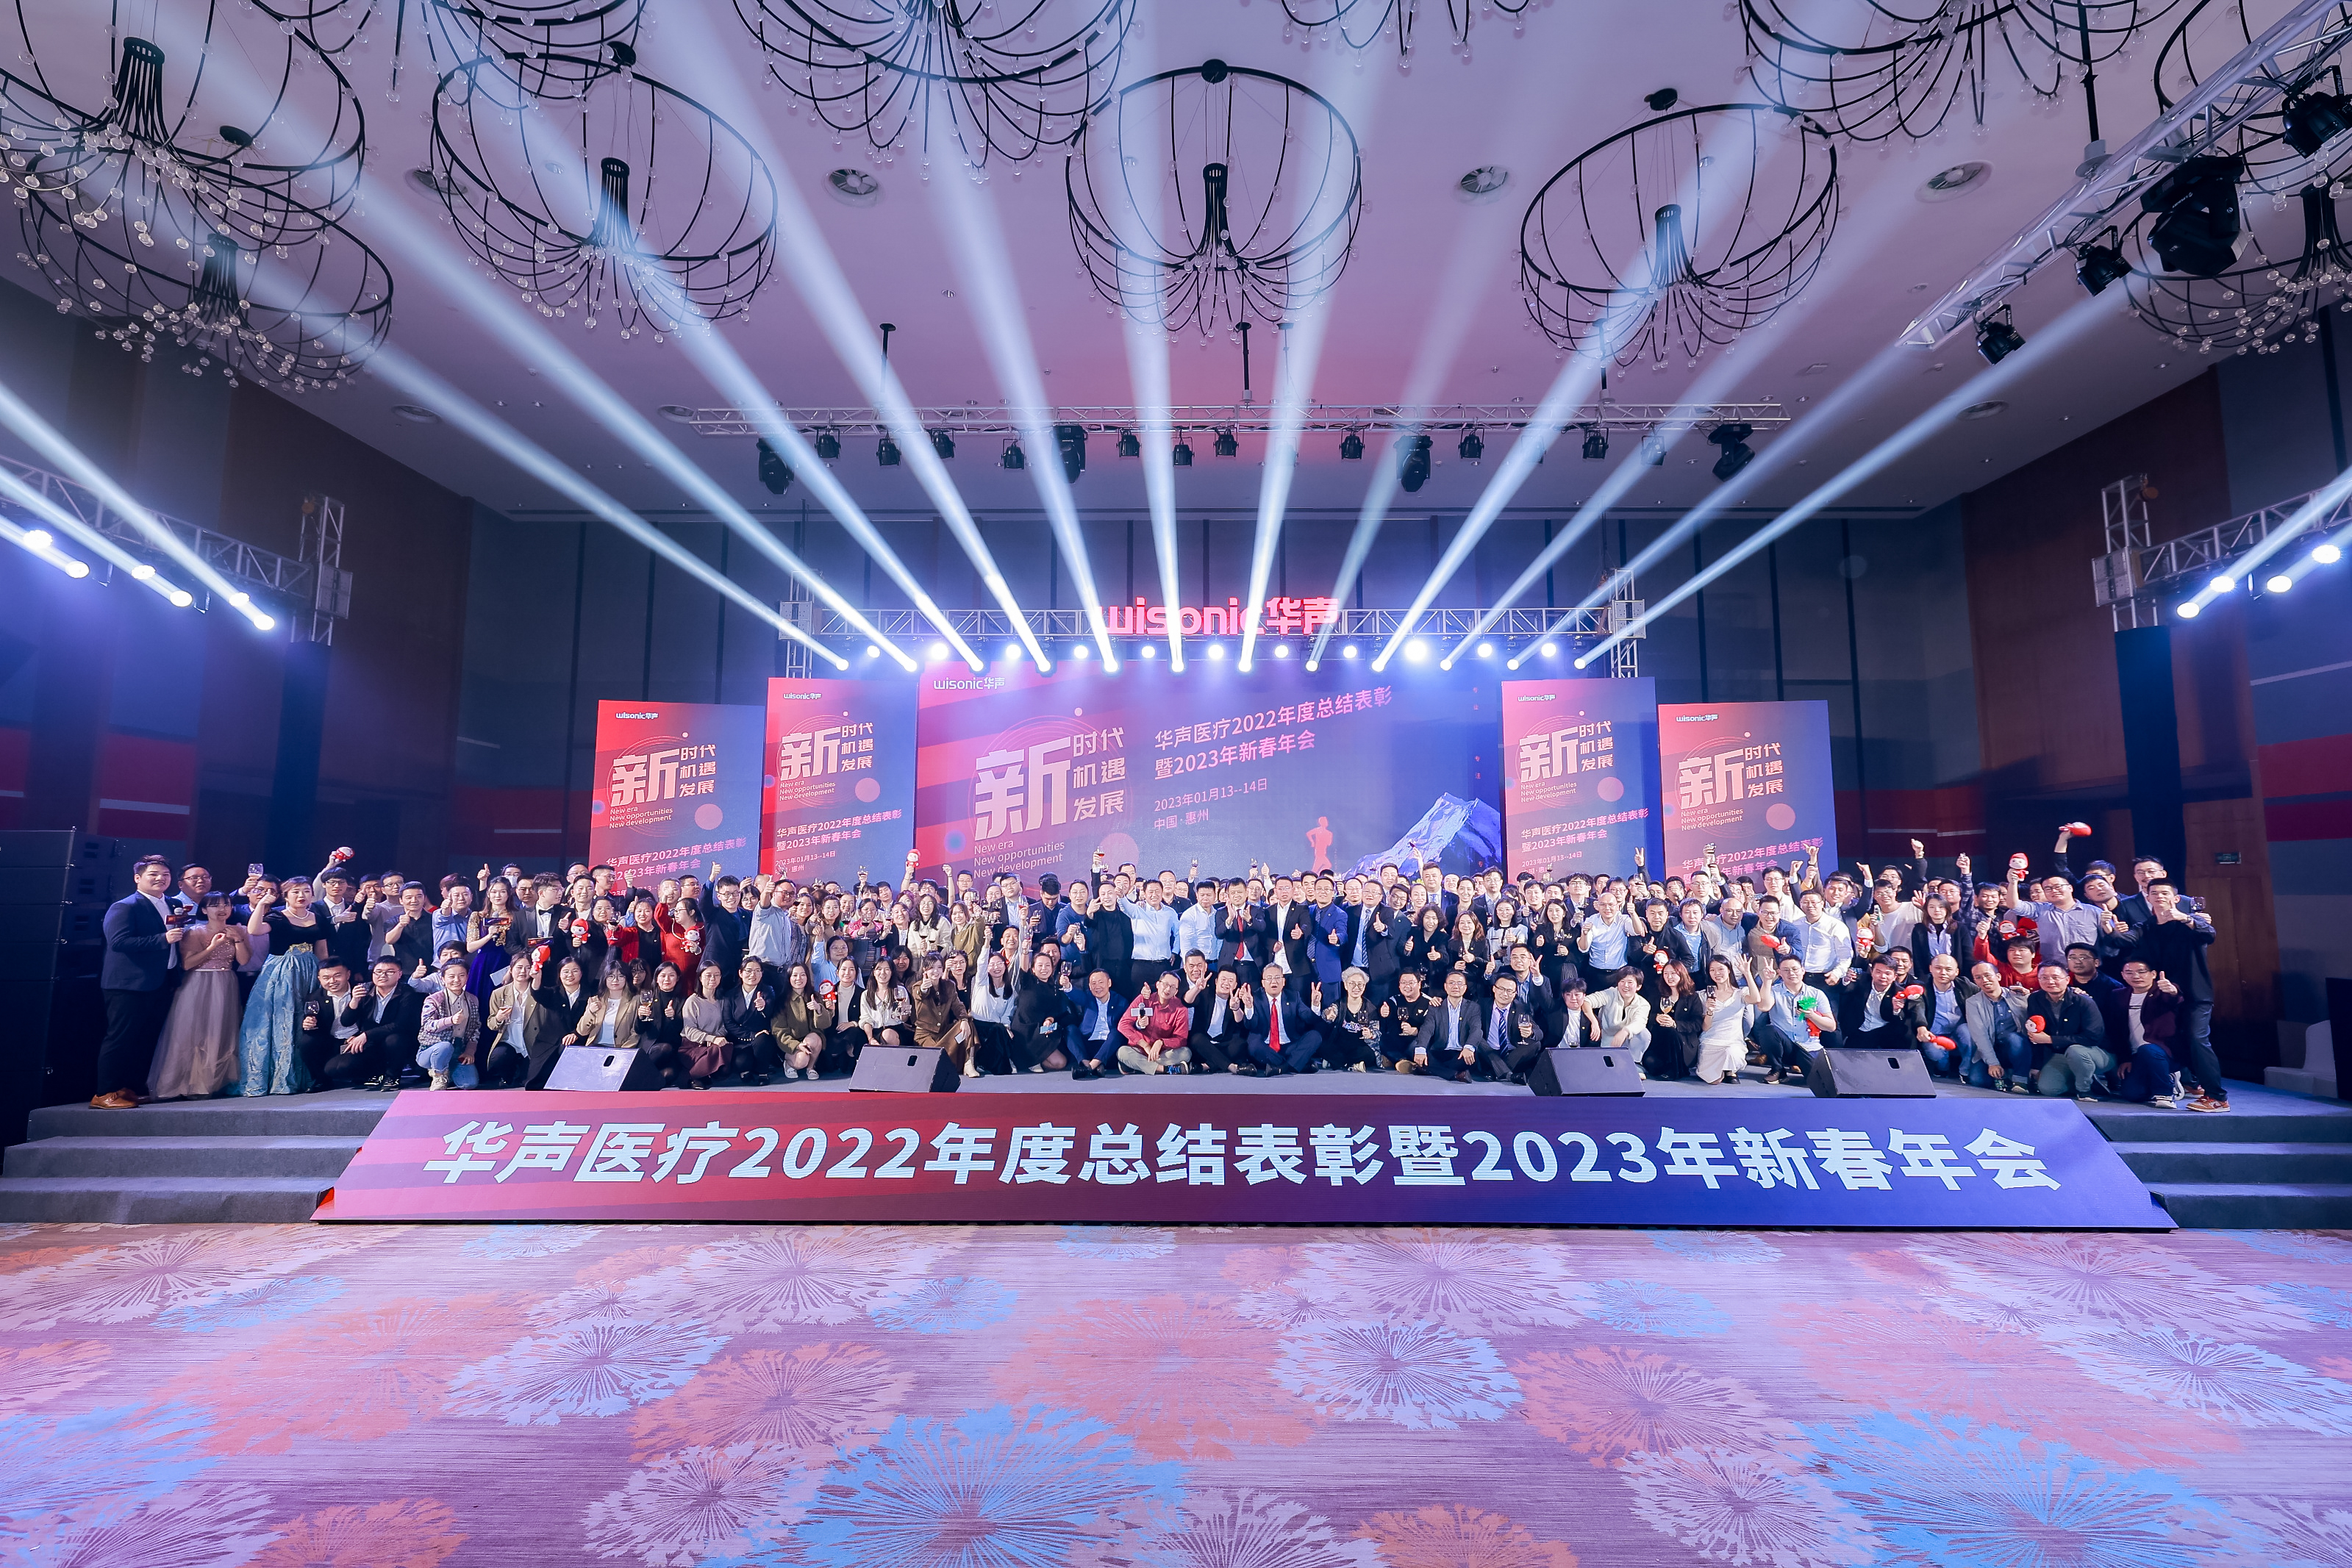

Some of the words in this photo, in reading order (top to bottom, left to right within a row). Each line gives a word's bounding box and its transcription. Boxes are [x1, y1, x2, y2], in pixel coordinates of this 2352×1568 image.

[933, 677, 1005, 690] wisonic华声
[1154, 685, 1393, 751] 华声医疗2022年度总结表彰
[841, 722, 873, 738] 时代
[1579, 720, 1612, 738] 时代
[840, 738, 873, 755] 机遇
[1073, 726, 1125, 757] 时代
[1579, 737, 1614, 755] 机遇
[680, 744, 716, 761] 时代
[780, 726, 841, 781] 新
[1154, 729, 1316, 780] 暨2023年新春年会
[1520, 726, 1579, 783] 新
[1745, 742, 1781, 761] 时代
[679, 761, 716, 779] 机遇
[840, 755, 873, 773] 发展
[1581, 753, 1614, 772] 发展
[1745, 760, 1784, 779] 机遇
[610, 748, 680, 807] 新
[1073, 757, 1126, 790] 机遇
[1679, 748, 1745, 809] 新
[679, 780, 715, 798] 发展
[794, 781, 836, 793] opportunities
[794, 787, 835, 799] development
[974, 736, 1071, 841] 新
[1154, 778, 1268, 812] 2023年01月13--14日
[1535, 781, 1577, 795] opportunities
[1535, 789, 1576, 800] development
[1747, 778, 1784, 798] 发展
[610, 814, 625, 822] New
[626, 807, 673, 820] opportunities
[1073, 789, 1125, 822] 发展
[626, 815, 672, 826] development
[776, 809, 902, 838] 华声医疗2022年度总结表彰
[1521, 808, 1648, 840] 华声医疗2022年度总结表彰
[1697, 809, 1744, 822] opportunities
[1698, 815, 1743, 828] development
[776, 828, 862, 851] 暨2023年新春年会
[974, 843, 996, 855] New
[998, 840, 1014, 850] era
[1521, 828, 1608, 853] 暨2023年新春年会
[973, 855, 996, 867] New
[998, 842, 1065, 863] opportunities
[973, 868, 996, 879] New
[998, 853, 1063, 873] development
[422, 1120, 2062, 1191] 华声医疗2022年度总结表彰暨2023年新春年会
